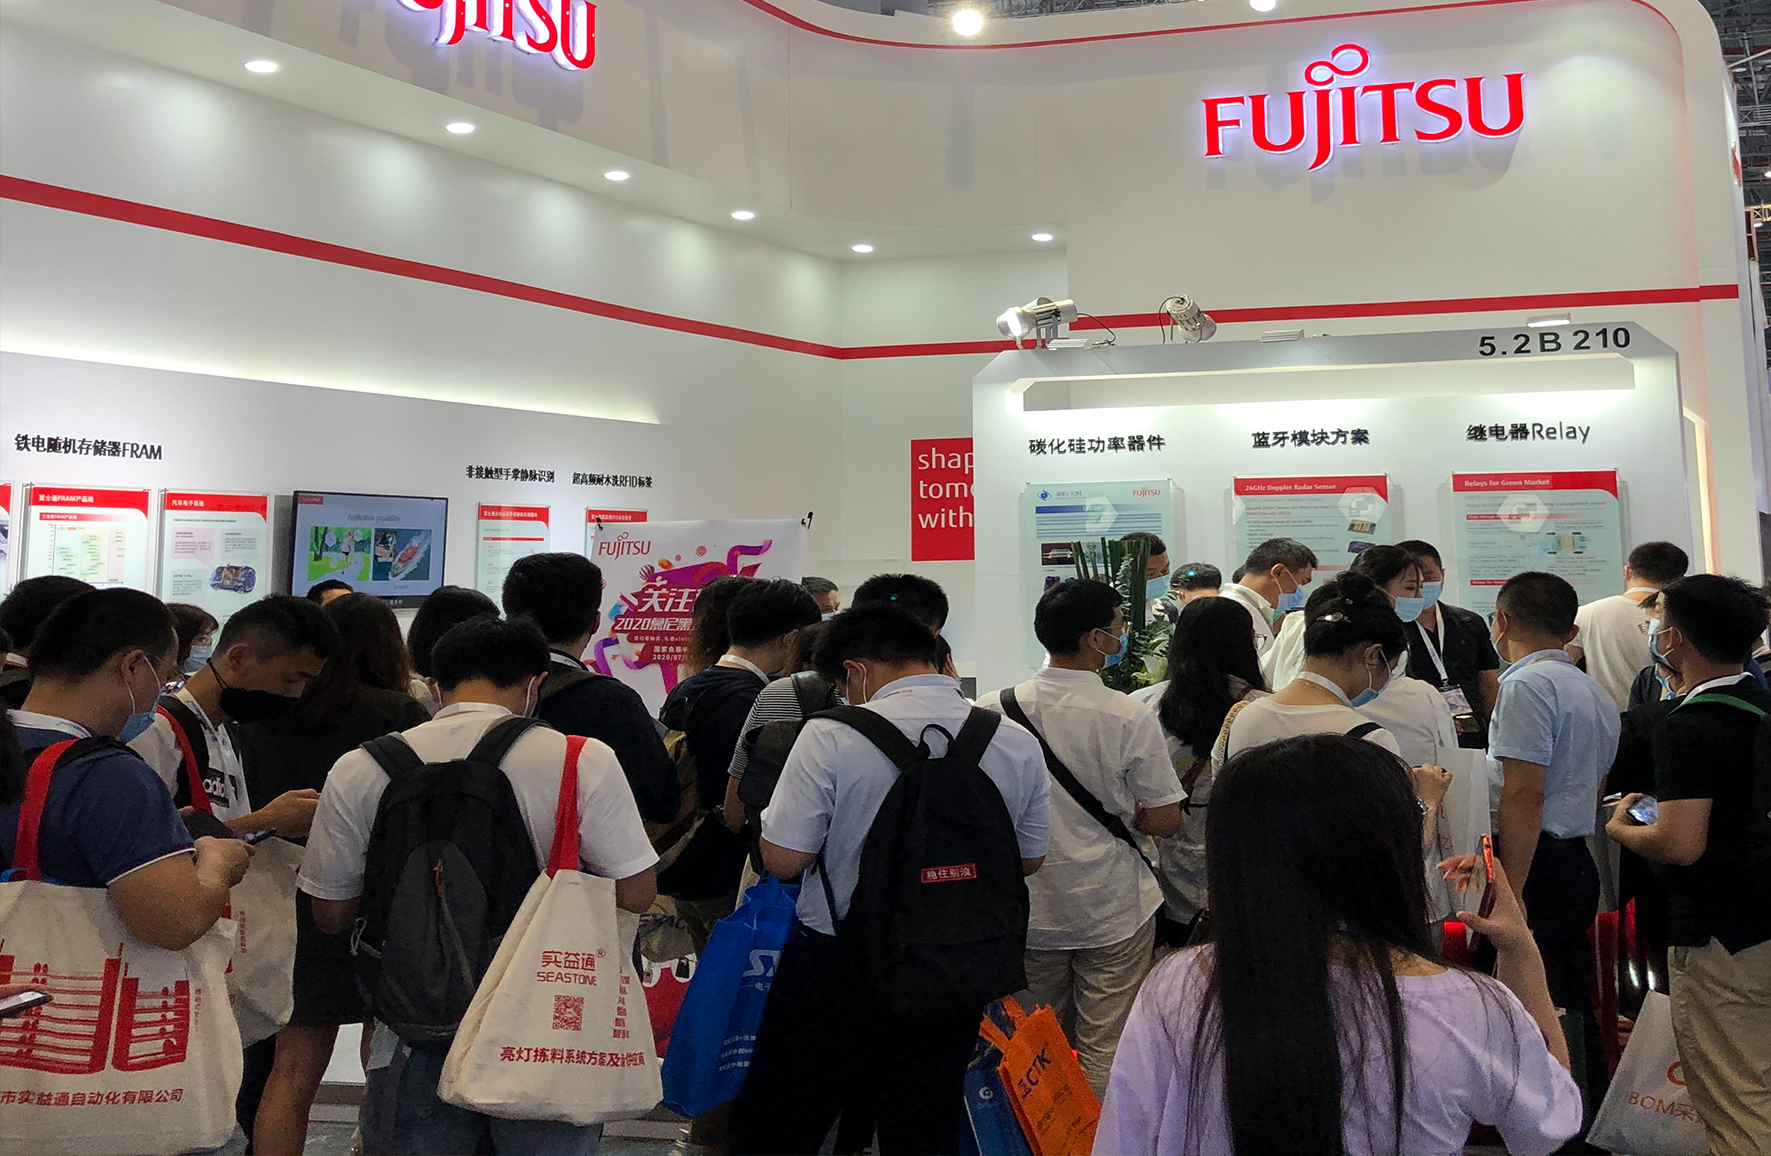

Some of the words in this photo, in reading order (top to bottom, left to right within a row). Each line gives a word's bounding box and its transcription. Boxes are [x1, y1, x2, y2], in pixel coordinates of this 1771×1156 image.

[1202, 44, 1526, 172] FUJITSU
[1251, 428, 1370, 448] 蓝牙模块方案
[1465, 421, 1590, 444] 继电器Relay
[14, 433, 163, 460] 铁电随机存储器FRAM
[1027, 434, 1166, 455] 碳化硅功率器件
[466, 465, 555, 483] 非接触型手掌静脉识别
[572, 472, 653, 488] 超高频耐水洗RFID标签
[1464, 480, 1487, 488] Relays
[1132, 487, 1161, 498] FUJITSU
[1267, 484, 1292, 492] Doppler
[917, 505, 973, 529] with
[598, 532, 652, 560] FUJITSU
[637, 588, 702, 612] 关注
[537, 971, 597, 986] SEASTONE
